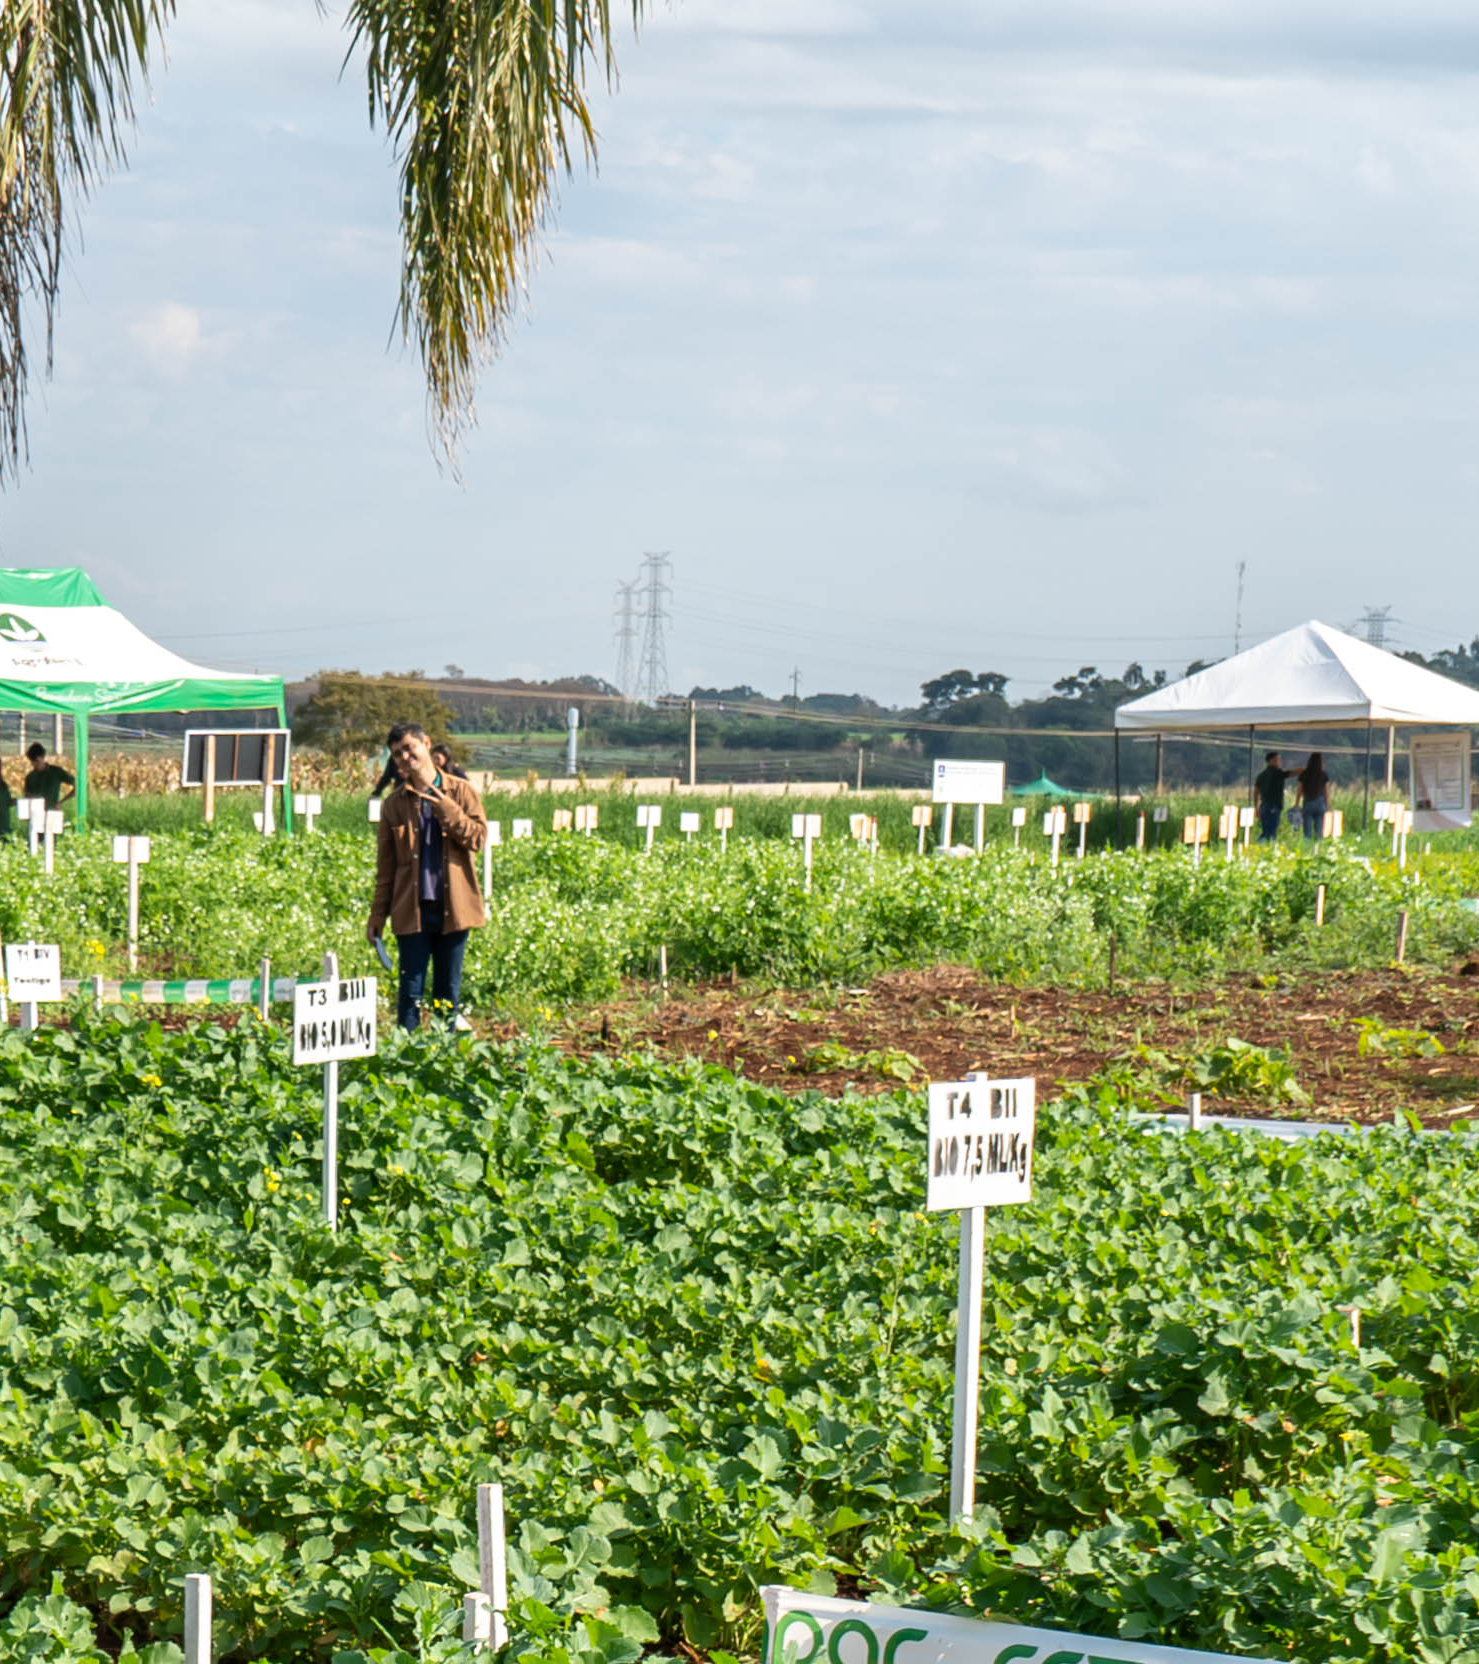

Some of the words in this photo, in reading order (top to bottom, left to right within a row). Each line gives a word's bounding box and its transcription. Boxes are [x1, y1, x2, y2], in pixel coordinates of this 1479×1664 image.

[307, 988, 327, 1006] T3
[339, 979, 365, 1001] BIII
[947, 1091, 972, 1120] T4
[990, 1088, 1017, 1119] BII
[934, 1135, 958, 1177] BIO
